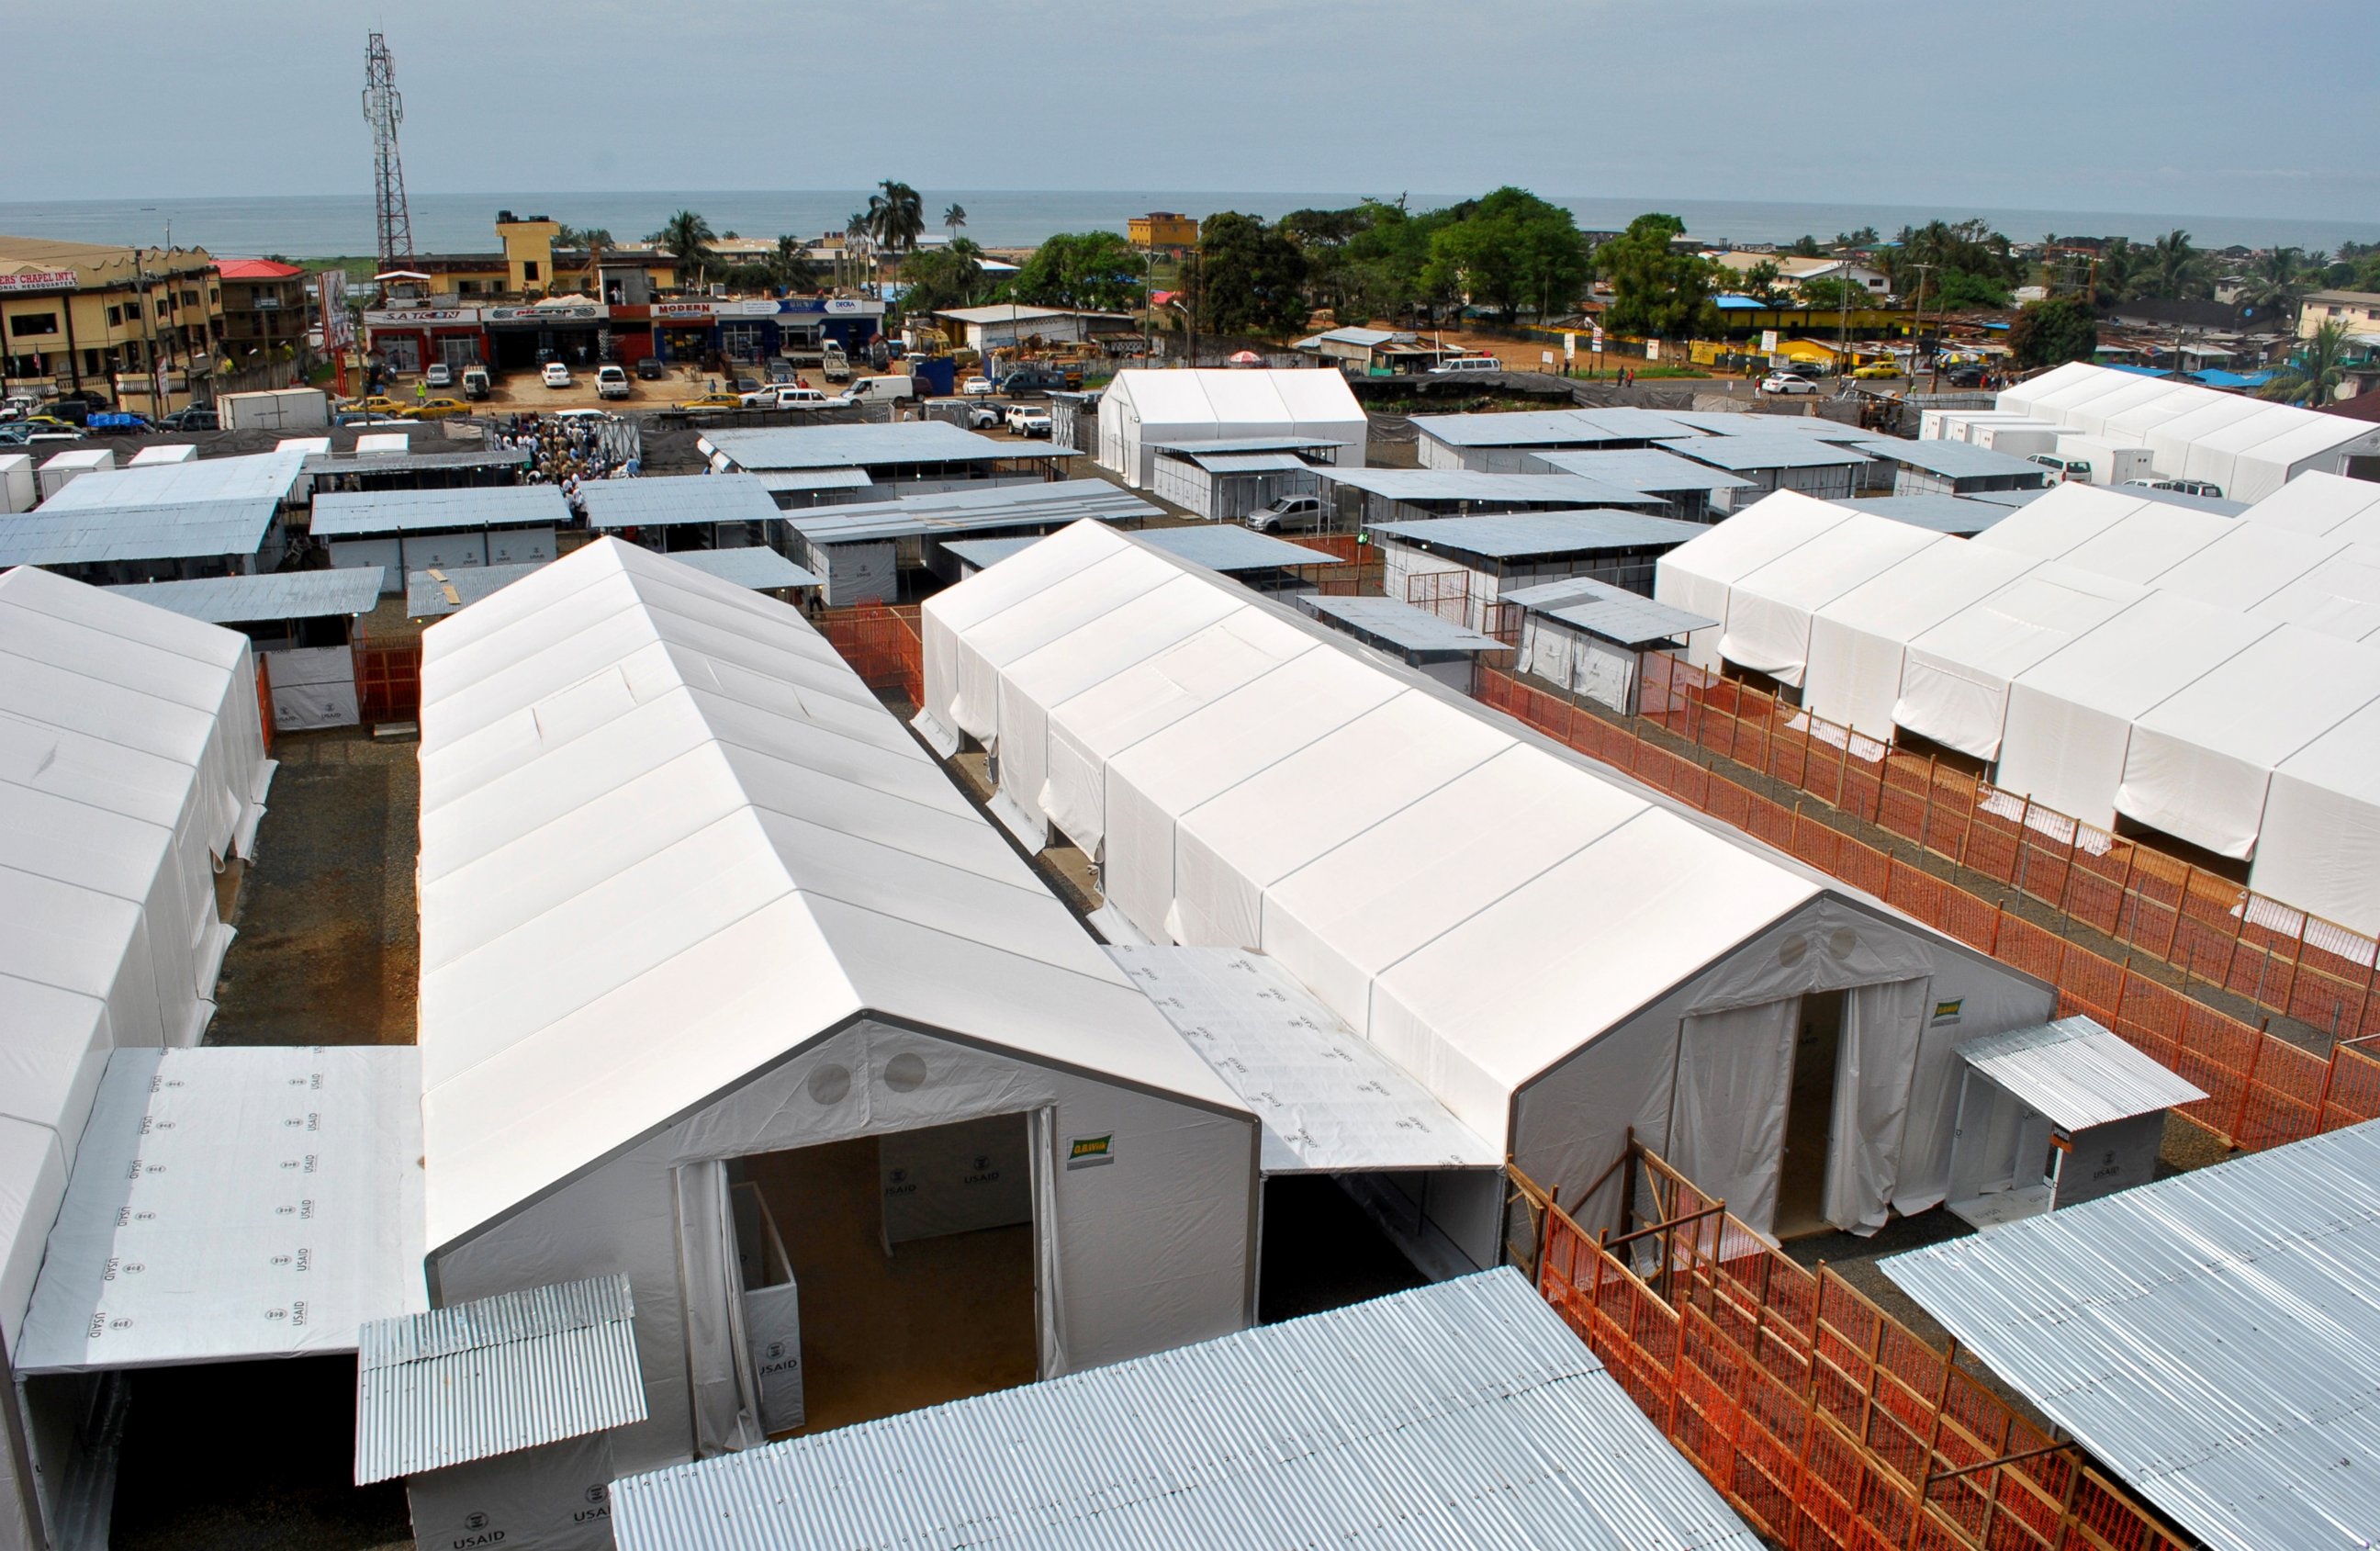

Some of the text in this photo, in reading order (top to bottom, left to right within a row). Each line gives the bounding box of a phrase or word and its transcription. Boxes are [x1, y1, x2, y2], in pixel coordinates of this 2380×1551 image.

[20, 273, 53, 284] CHAPEL
[55, 271, 76, 281] INT'L
[22, 280, 78, 289] HEADQUARTERS
[387, 311, 458, 320] SATCON
[658, 304, 710, 313] MODERN
[310, 1073, 320, 1090] USAID
[308, 1113, 318, 1131] USAID
[304, 1154, 315, 1174] USAID
[964, 1172, 1000, 1184] USAID
[301, 1199, 311, 1219] USAID
[297, 1248, 309, 1271] USAID
[292, 1301, 305, 1326] USAID
[574, 1506, 612, 1523] USAI
[454, 1530, 505, 1550] USAID
